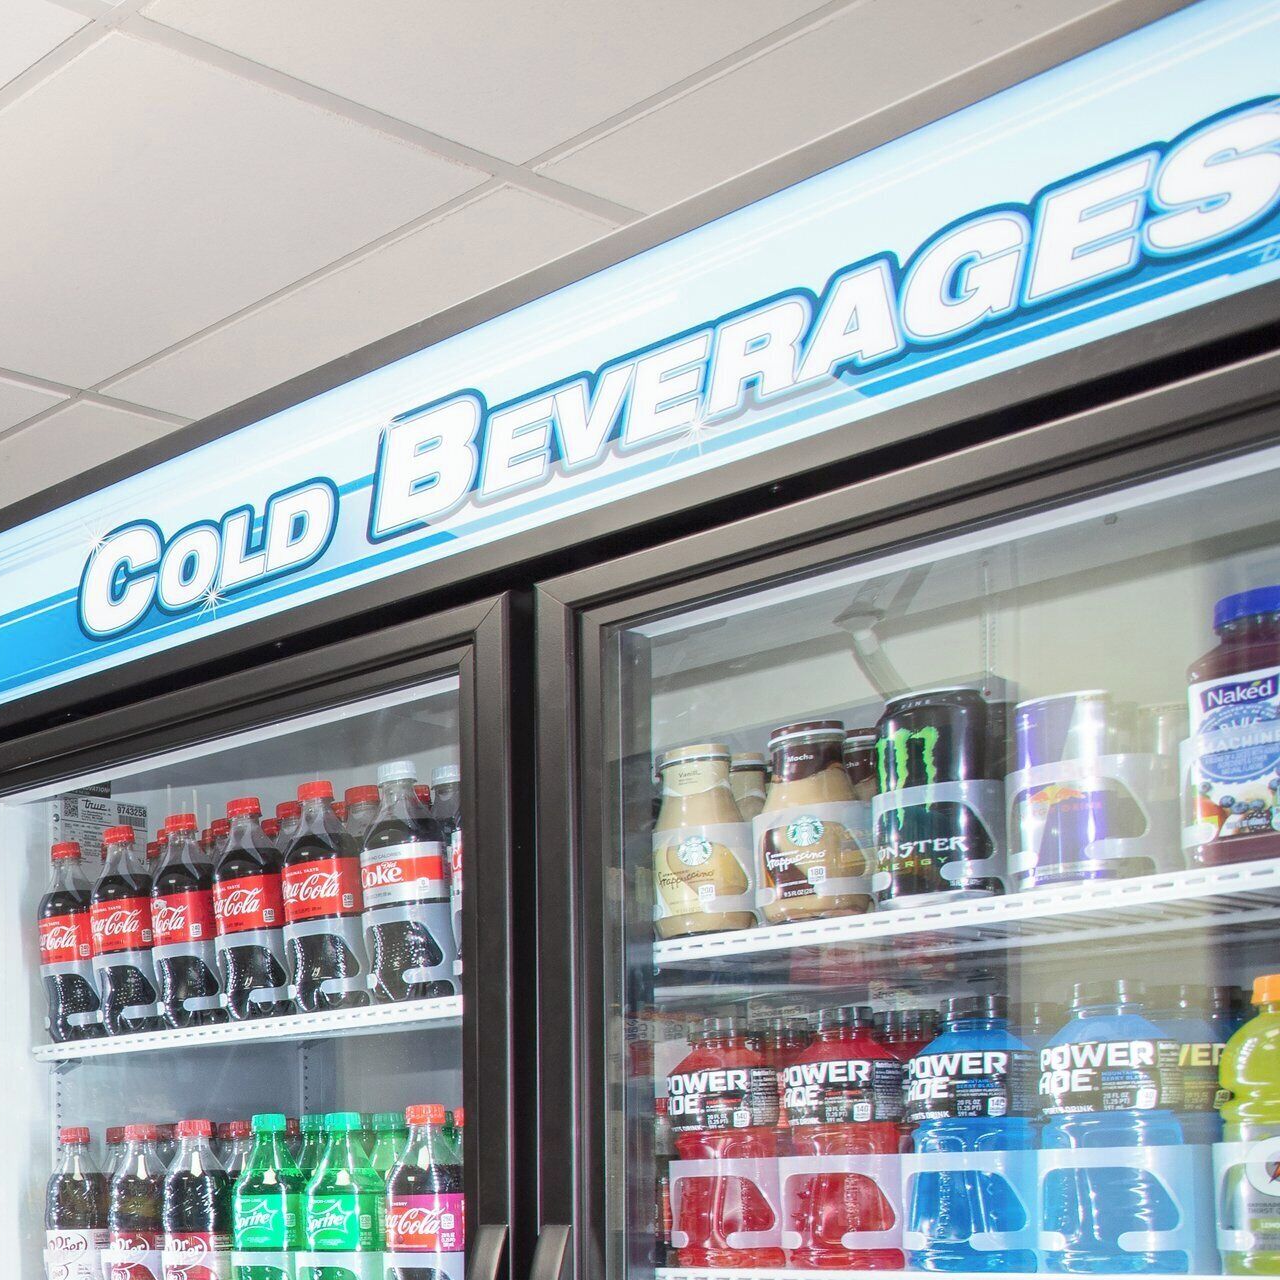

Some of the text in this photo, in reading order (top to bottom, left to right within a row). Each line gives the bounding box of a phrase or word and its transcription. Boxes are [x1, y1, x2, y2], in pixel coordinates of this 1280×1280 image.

[78, 97, 1280, 641] COLD BEVERAGES
[1206, 681, 1274, 707] Naked
[361, 866, 403, 887] Coke
[1040, 1041, 1154, 1067] POWER
